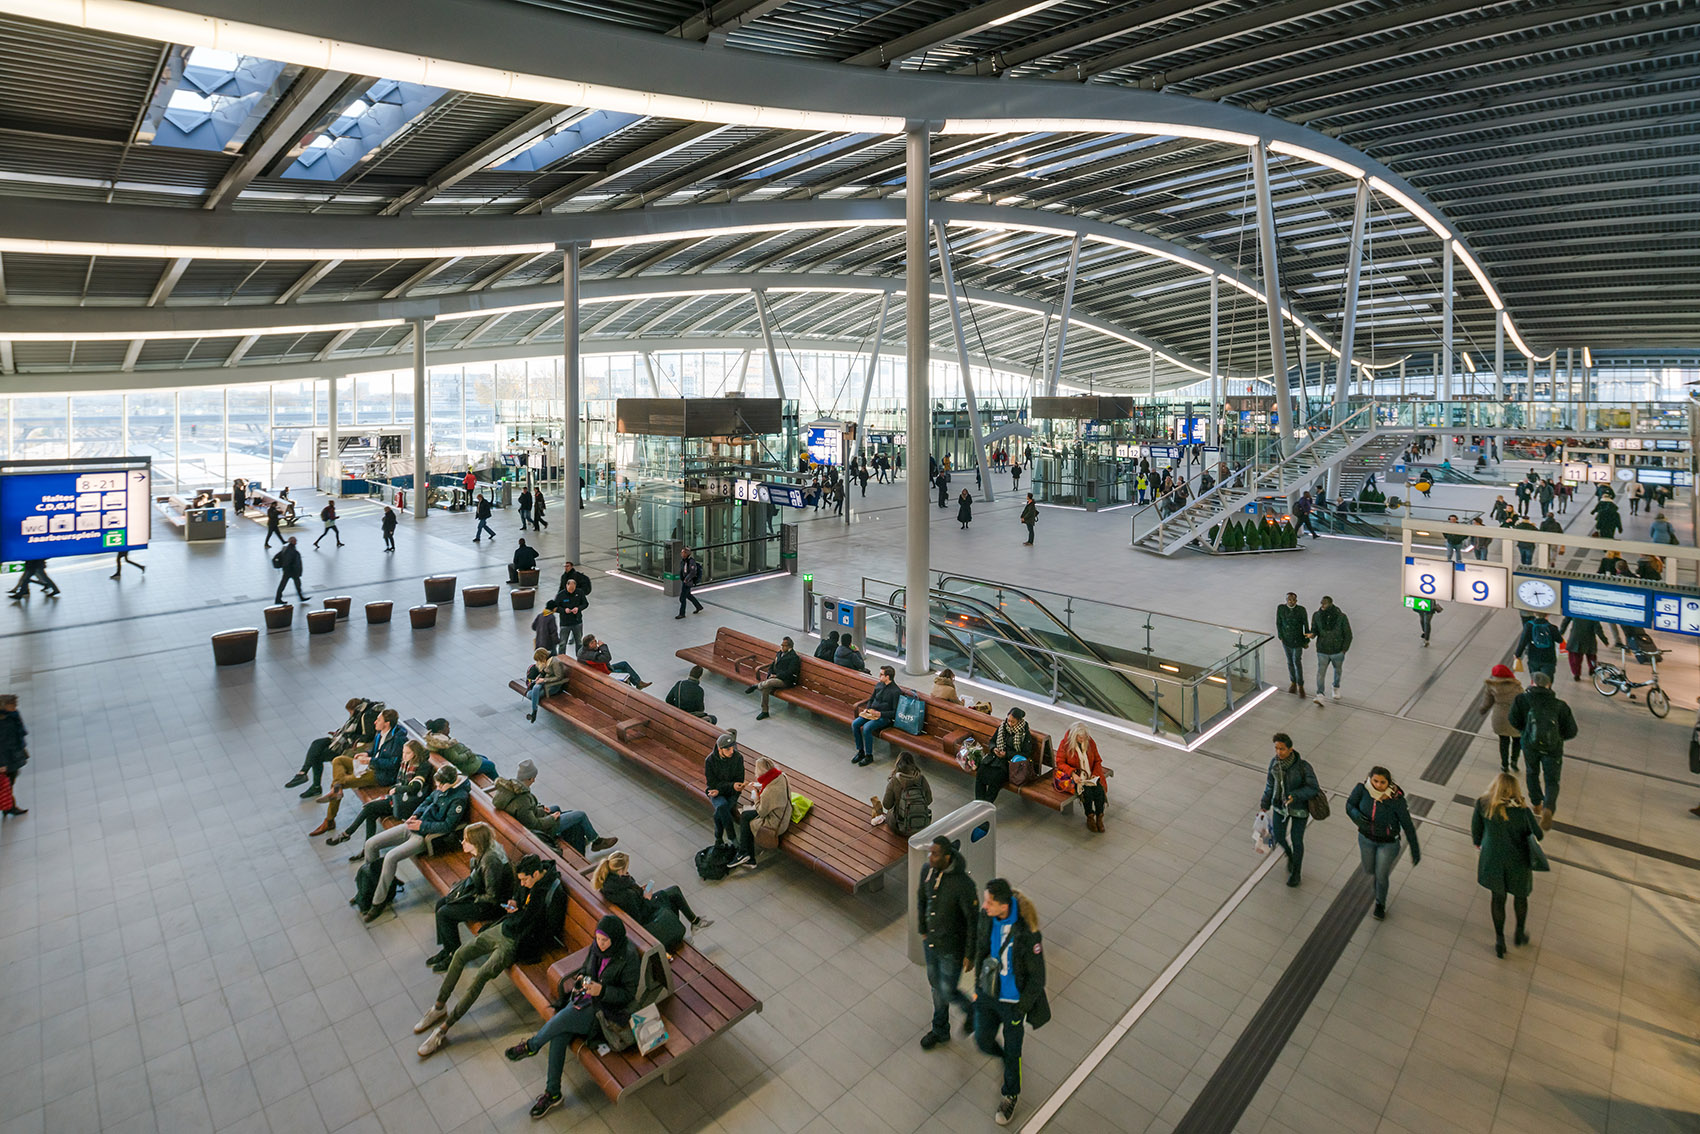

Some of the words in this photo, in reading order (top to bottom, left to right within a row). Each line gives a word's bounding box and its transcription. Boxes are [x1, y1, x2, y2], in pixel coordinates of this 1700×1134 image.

[1130, 449, 1139, 457] 12
[1569, 469, 1581, 480] 11
[1592, 471, 1608, 481] 12
[738, 486, 744, 498] 8
[752, 488, 758, 500] 9
[1419, 573, 1436, 595] 8
[1472, 580, 1489, 602] 9
[1663, 603, 1672, 612] 8
[1663, 619, 1672, 628] 9
